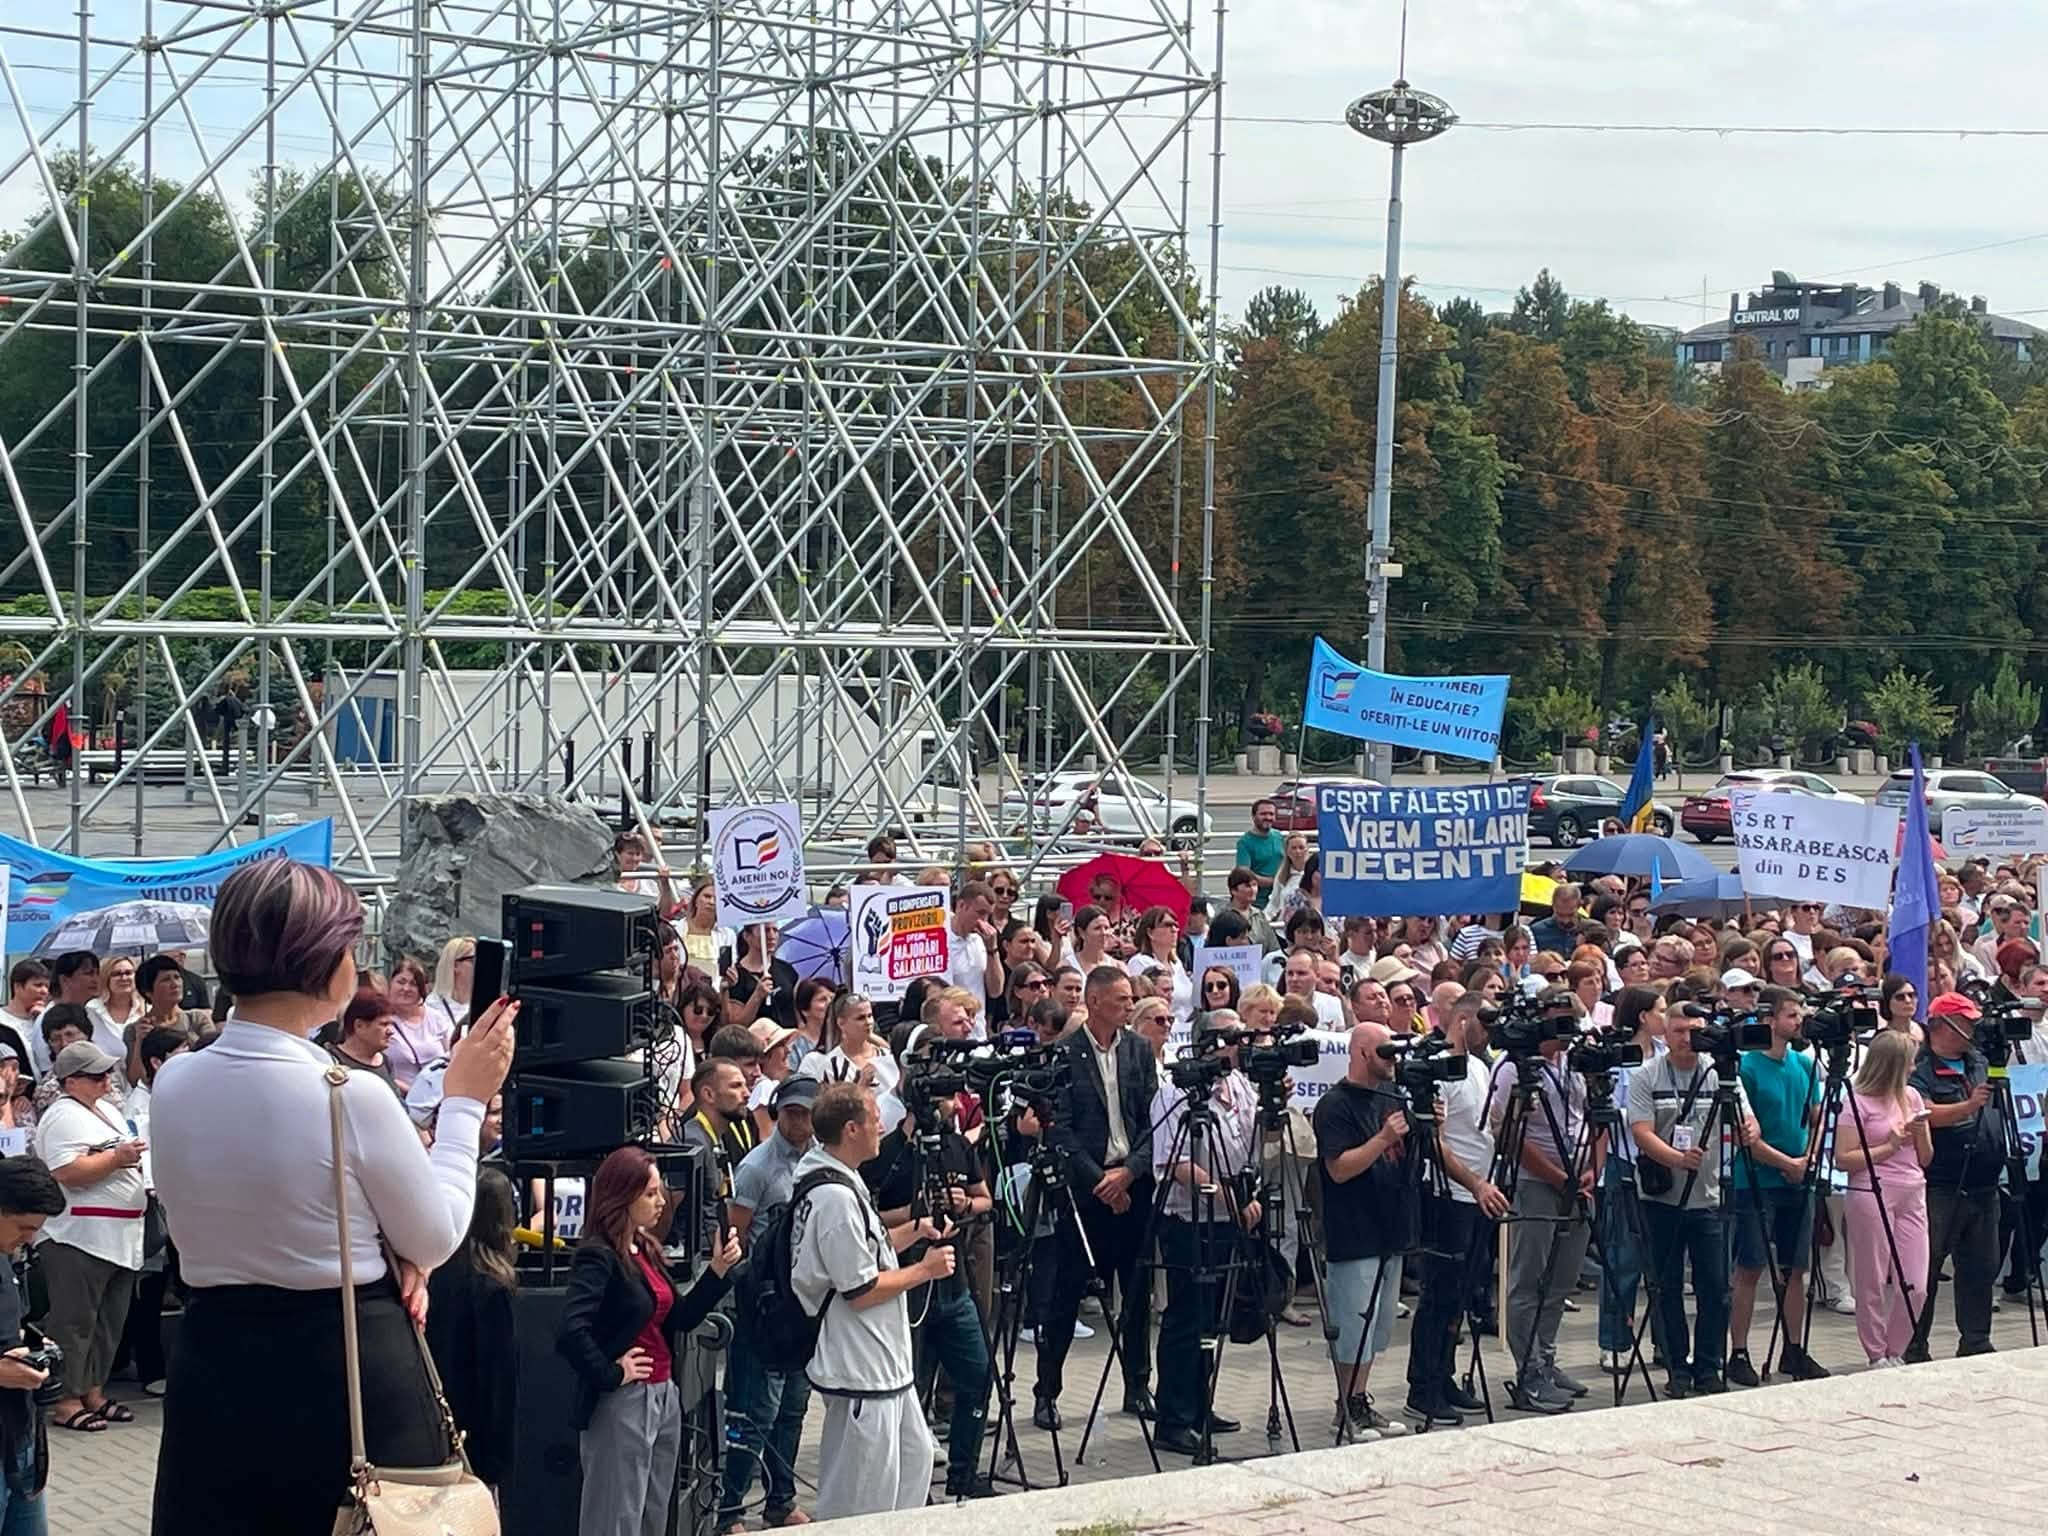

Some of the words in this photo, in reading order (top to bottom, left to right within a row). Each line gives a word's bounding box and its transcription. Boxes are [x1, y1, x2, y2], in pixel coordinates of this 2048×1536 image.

[1734, 309, 1781, 324] CENTRAL
[1783, 308, 1800, 320] 101
[1390, 687, 1404, 703] ÎN
[1432, 719, 1452, 735] UN
[1454, 725, 1499, 746] VIITOR
[1321, 788, 1384, 813] CSRT
[1496, 785, 1528, 810] DE
[1339, 813, 1420, 849] VREM
[1434, 812, 1528, 848] SALARII
[1734, 833, 1890, 864] BASARABEASCA
[769, 870, 789, 881] NOI
[1324, 846, 1526, 881] DECENTE
[1755, 859, 1783, 875] din
[1798, 863, 1847, 884] DES
